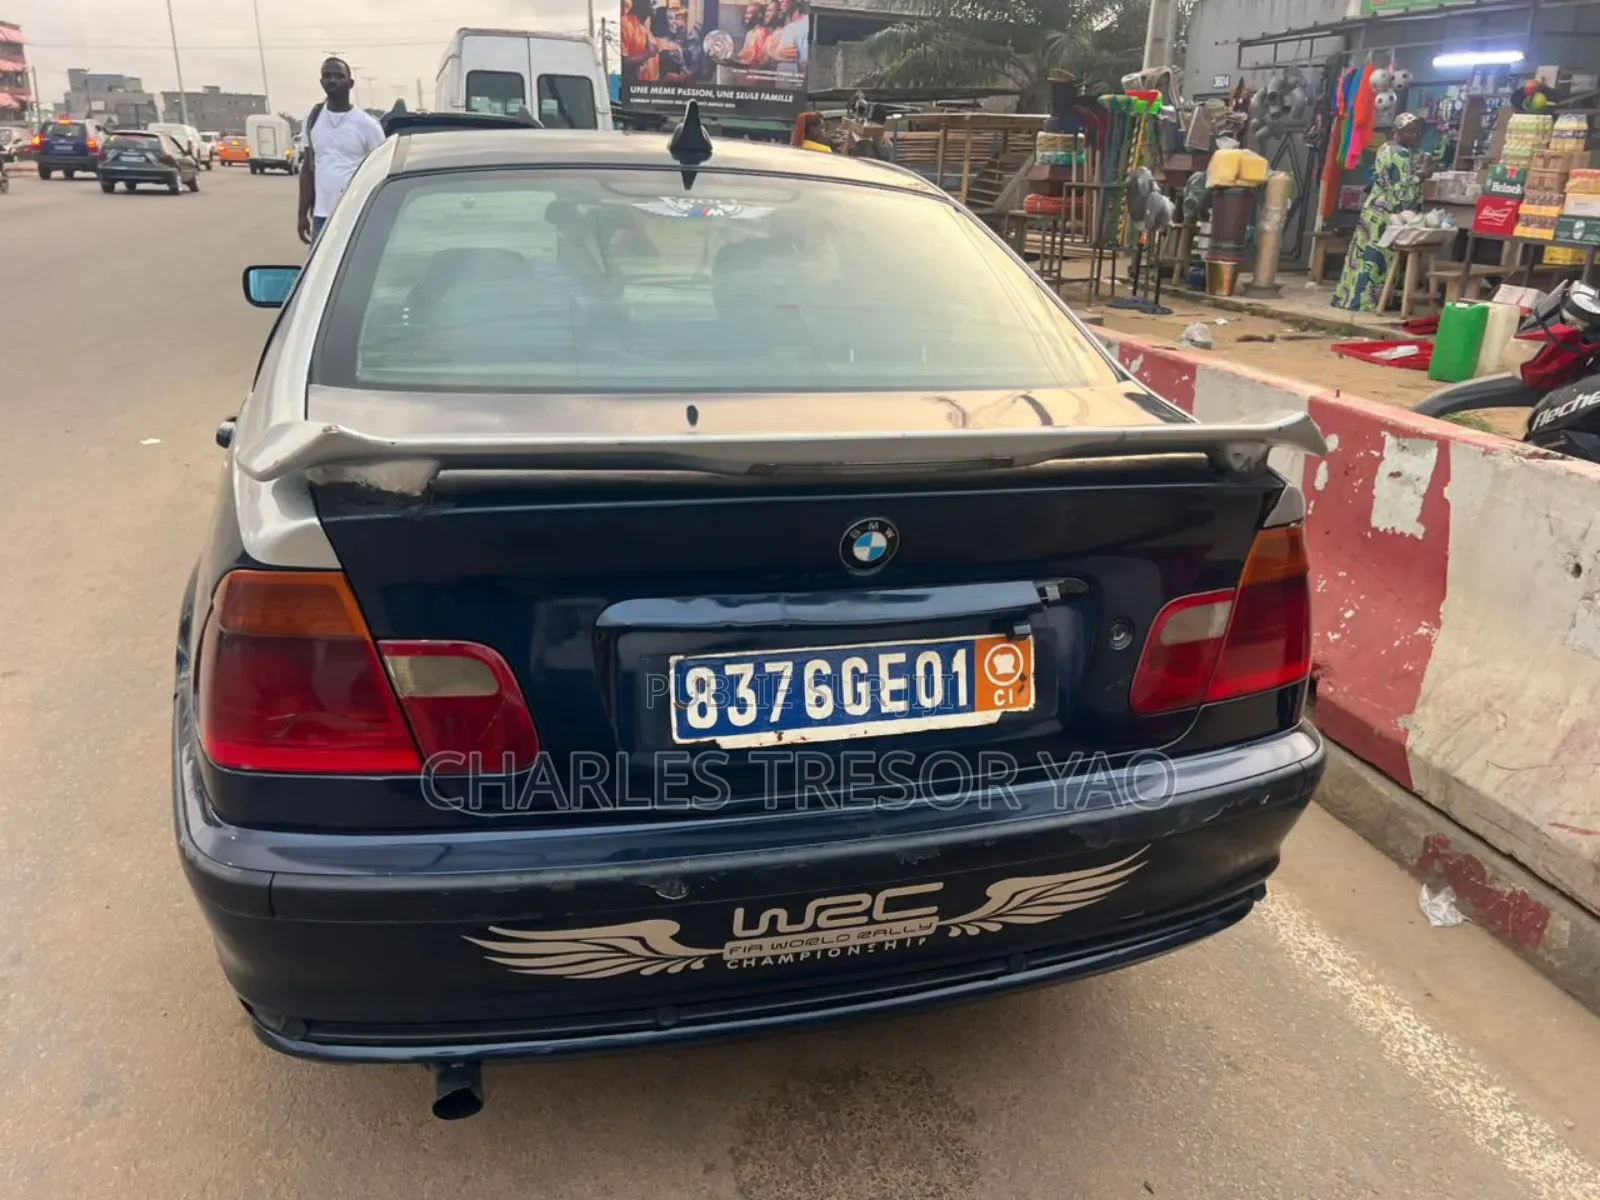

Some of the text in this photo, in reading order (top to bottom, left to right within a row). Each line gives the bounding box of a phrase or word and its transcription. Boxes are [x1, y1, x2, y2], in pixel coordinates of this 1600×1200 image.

[630, 86, 648, 94] UNE
[716, 90, 734, 99] UNE
[735, 91, 758, 101] SEULE
[760, 93, 794, 103] FAMILLE
[993, 688, 1014, 706] CI
[729, 922, 933, 956] FIA WORLD RALLY
[726, 937, 927, 970] CHAMPIONSHIP
